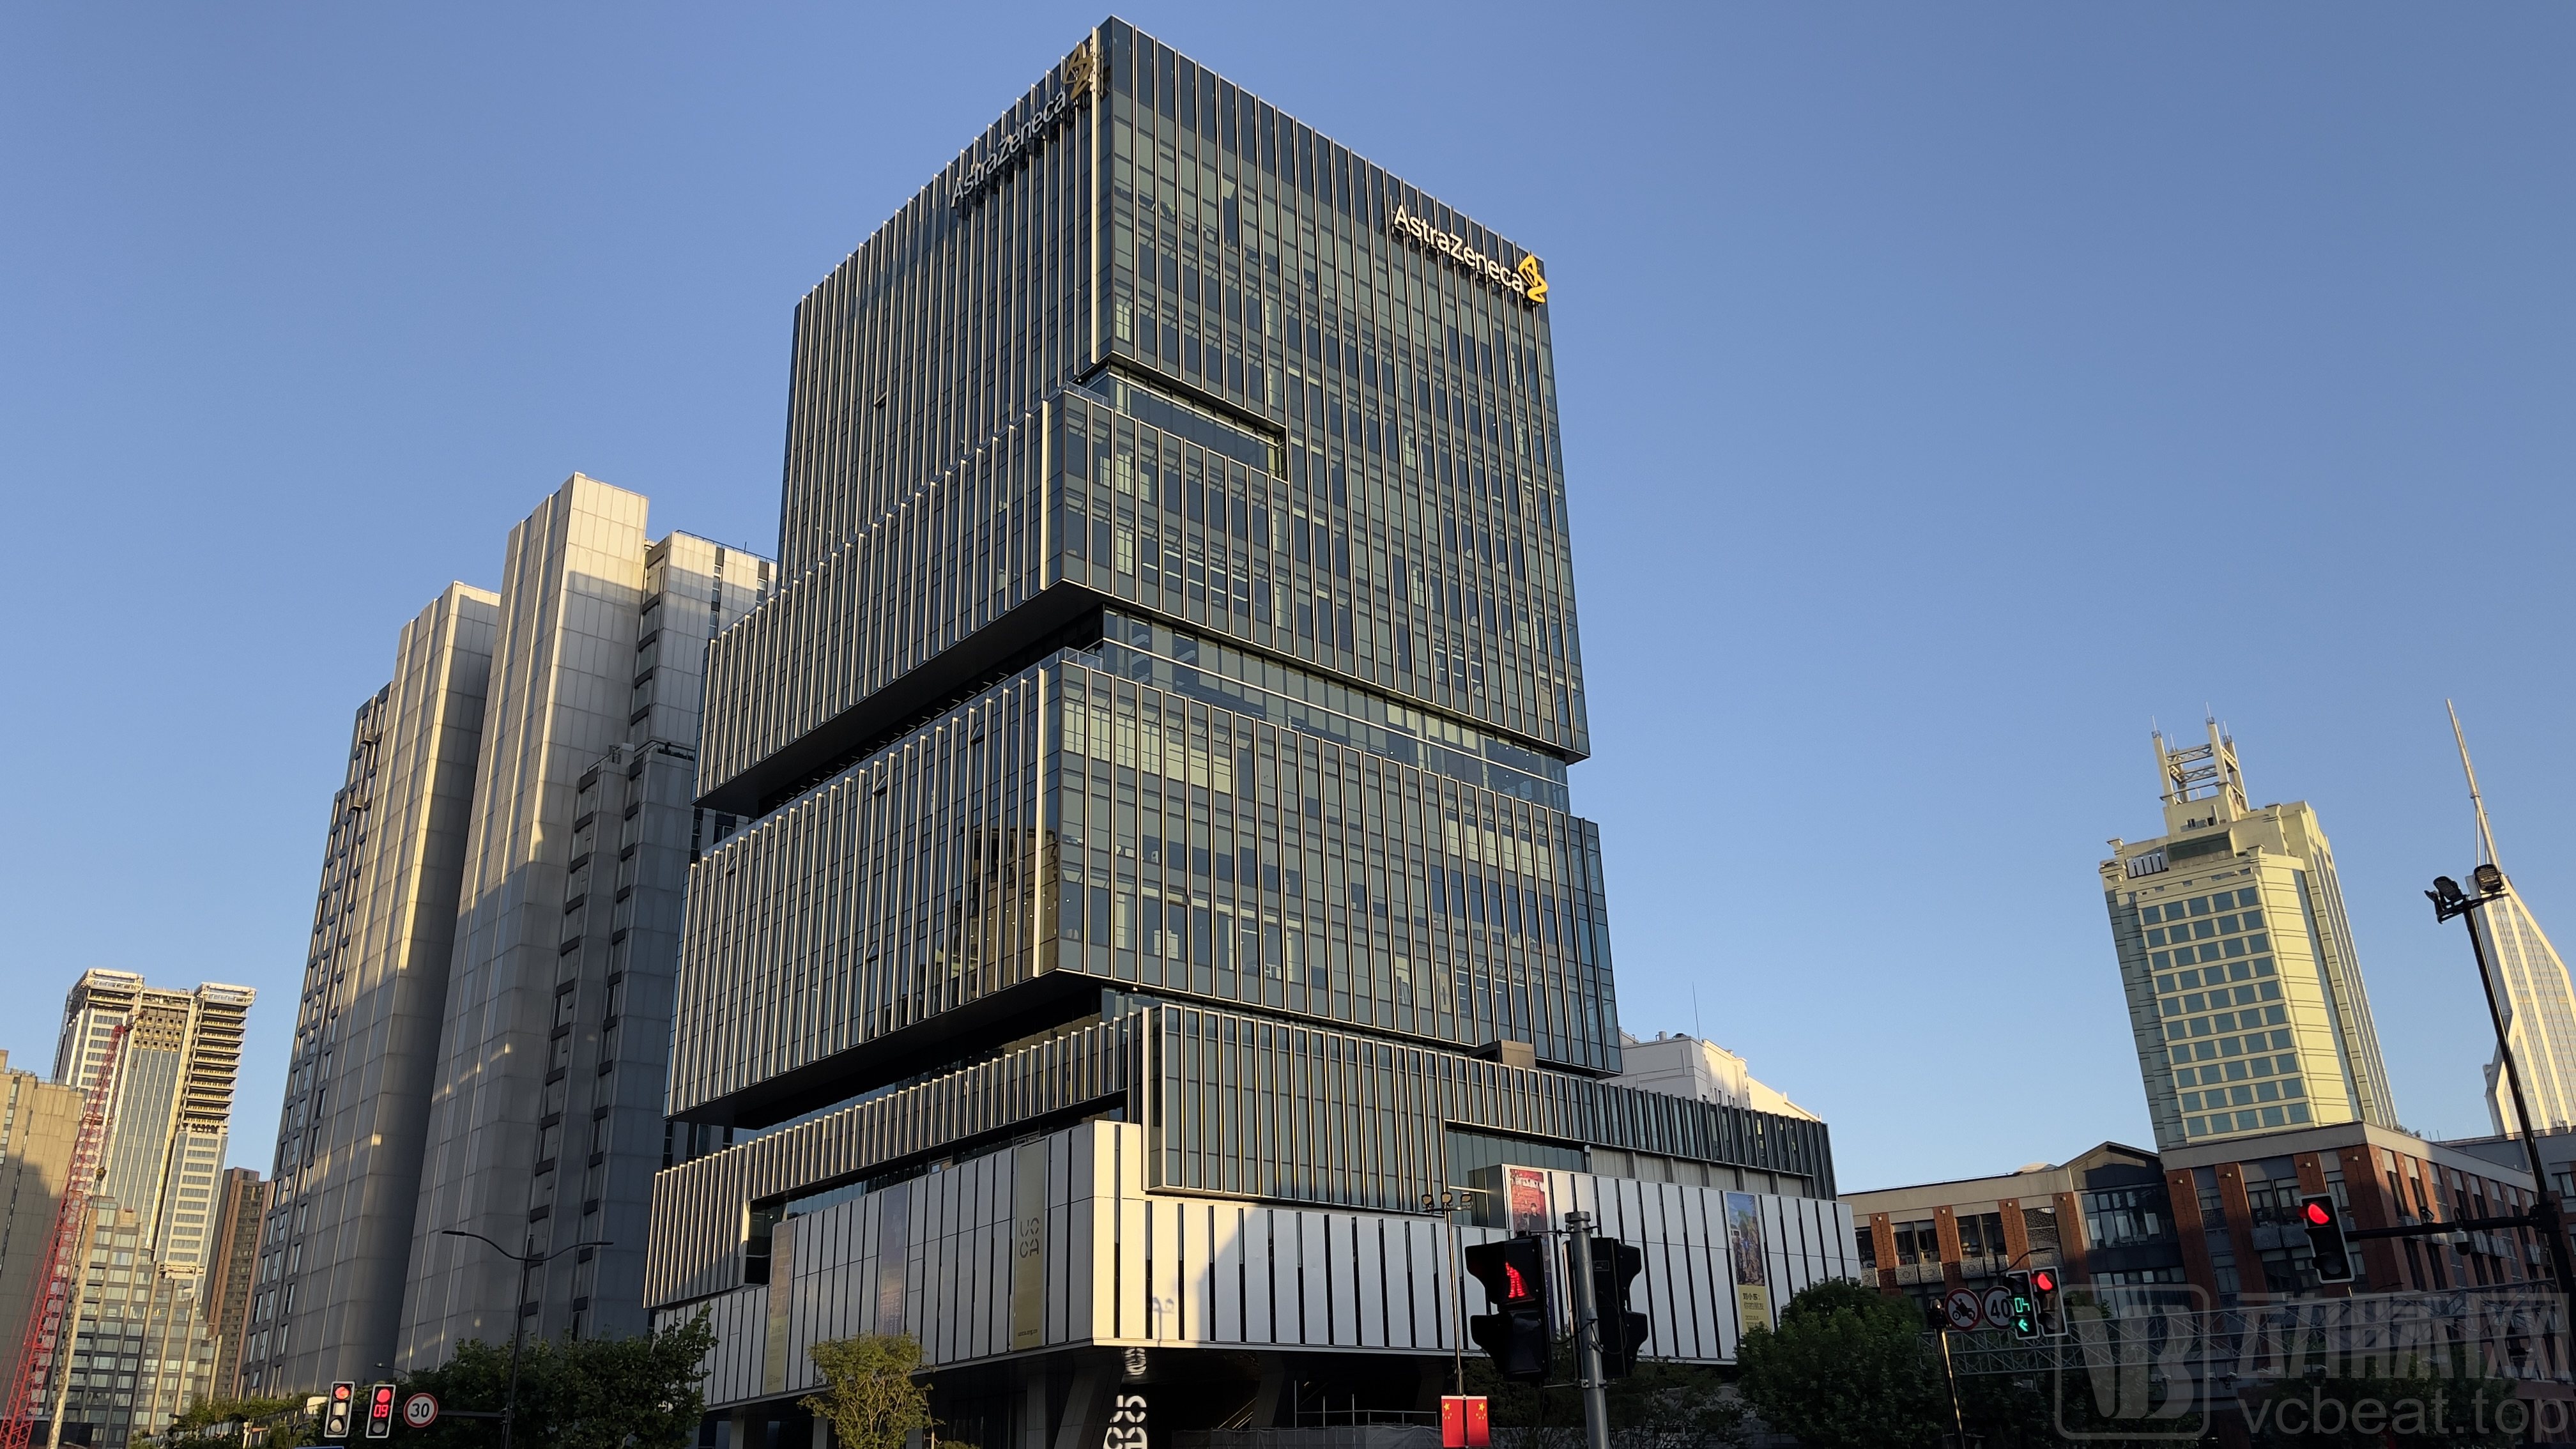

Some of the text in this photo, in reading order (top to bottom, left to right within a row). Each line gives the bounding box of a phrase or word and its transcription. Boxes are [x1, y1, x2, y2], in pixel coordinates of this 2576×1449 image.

[951, 90, 1067, 209] AstraZeneca
[1394, 204, 1524, 294] AstraZeneca
[1990, 1298, 2011, 1319] 40
[374, 1404, 388, 1417] 09
[411, 1403, 429, 1418] 30
